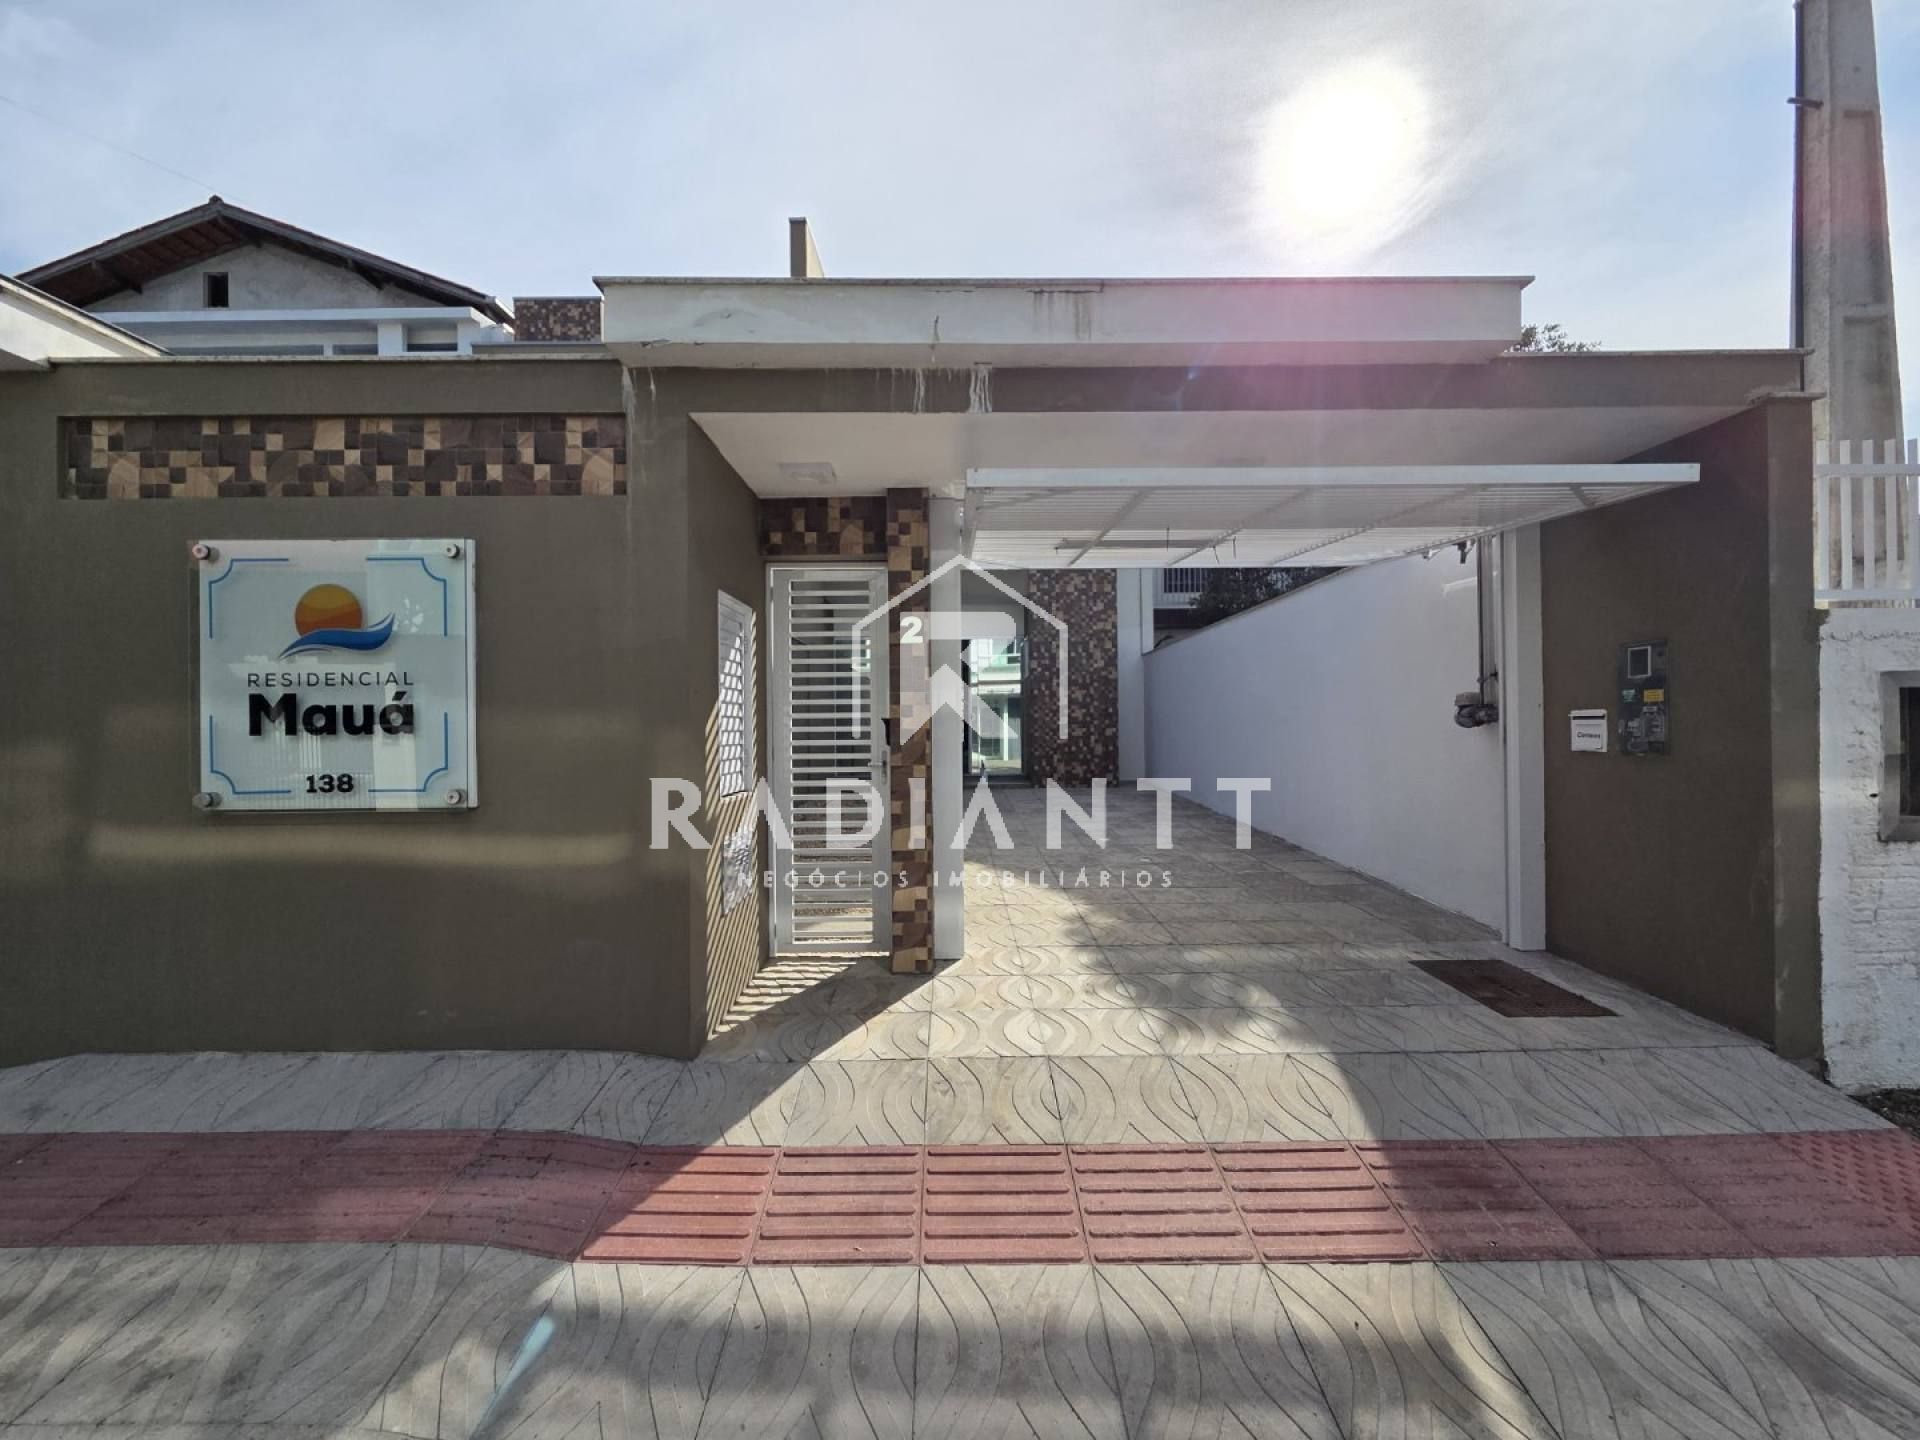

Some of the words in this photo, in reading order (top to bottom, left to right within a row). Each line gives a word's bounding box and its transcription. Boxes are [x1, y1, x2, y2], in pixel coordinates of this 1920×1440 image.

[901, 615, 924, 644] 2
[247, 671, 414, 688] RESIDENCIAL
[248, 690, 415, 737] Mauá
[306, 773, 354, 794] 138
